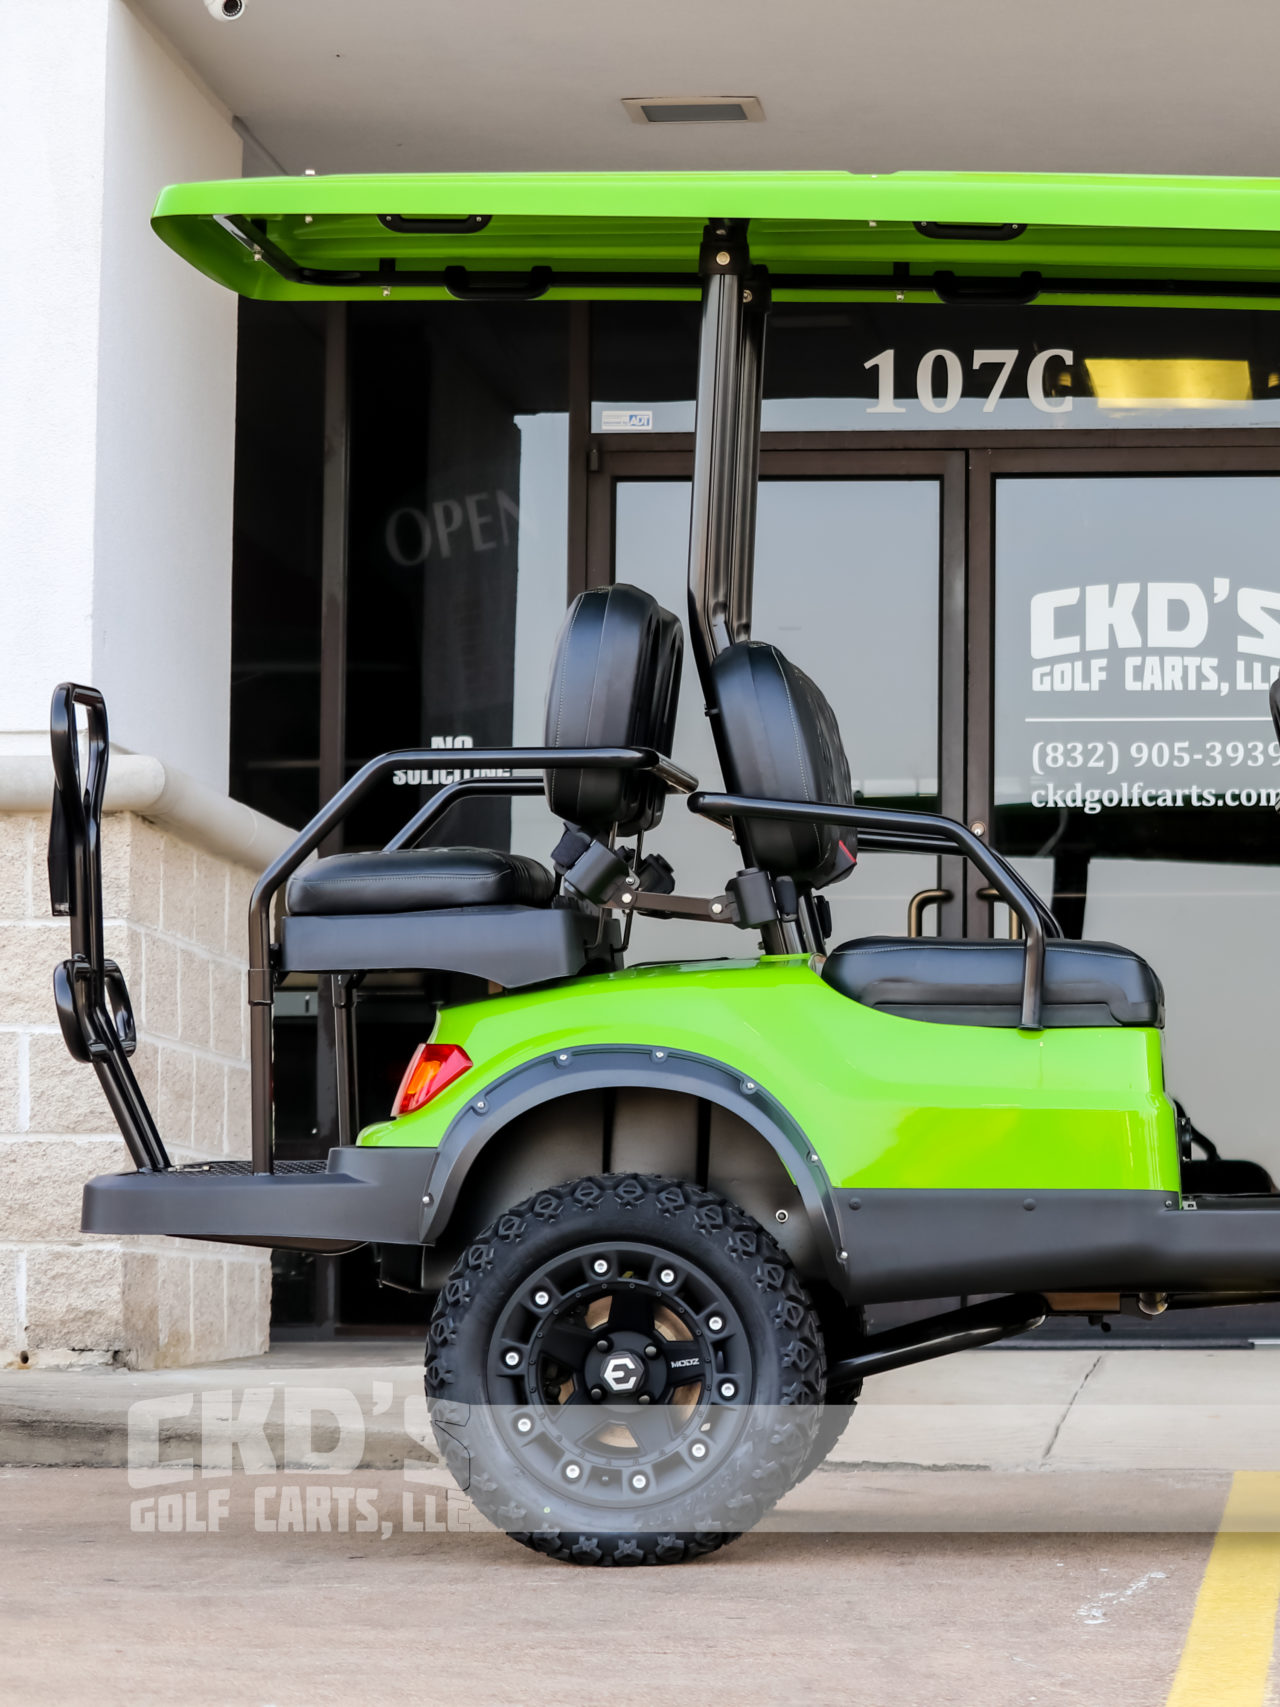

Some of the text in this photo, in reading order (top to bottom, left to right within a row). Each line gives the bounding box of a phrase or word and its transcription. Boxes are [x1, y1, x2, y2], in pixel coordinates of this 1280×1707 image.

[862, 347, 1075, 414] 107C
[630, 415, 650, 426] ADT
[1032, 658, 1107, 692] GOLF
[1125, 656, 1229, 696] CARTS,
[1031, 741, 1119, 775] (832)
[670, 1357, 700, 1369] MODZ
